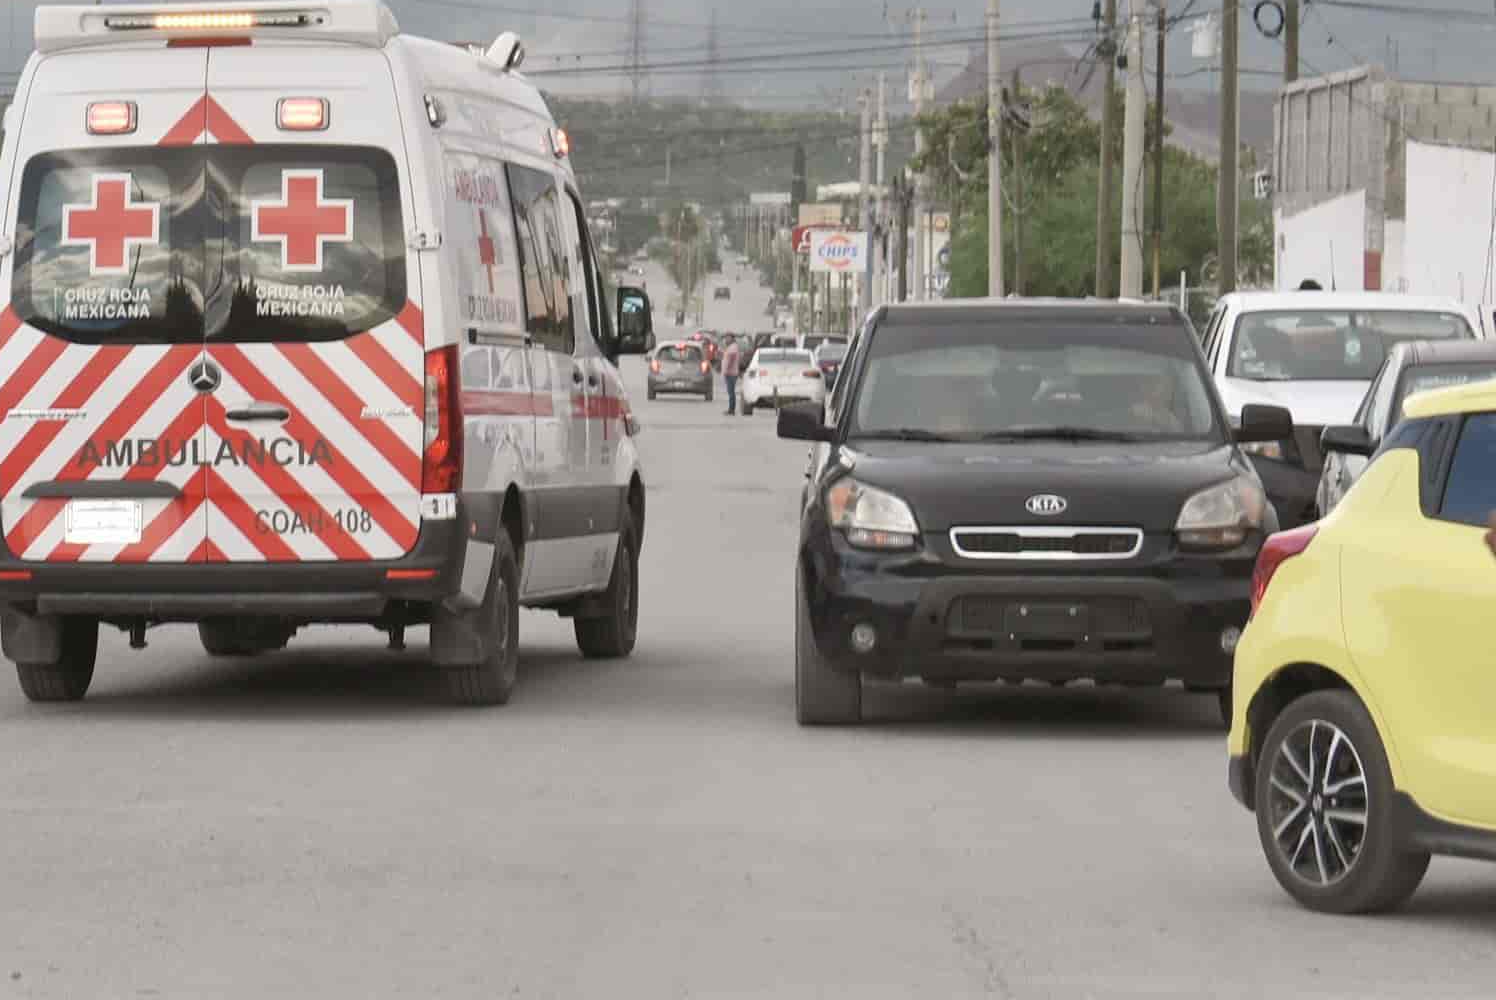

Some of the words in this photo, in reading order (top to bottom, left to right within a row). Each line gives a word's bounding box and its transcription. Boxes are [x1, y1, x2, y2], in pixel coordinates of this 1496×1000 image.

[817, 243, 859, 258] CHIPS
[64, 288, 106, 303] CRUZ
[110, 288, 151, 303] ROJA
[255, 285, 301, 300] CRUZ
[303, 284, 345, 300] ROJA
[64, 303, 152, 319] MEXICANA
[255, 300, 346, 317] MEXICANA
[77, 436, 334, 468] AMBULANCIA
[1032, 496, 1061, 512] KIA
